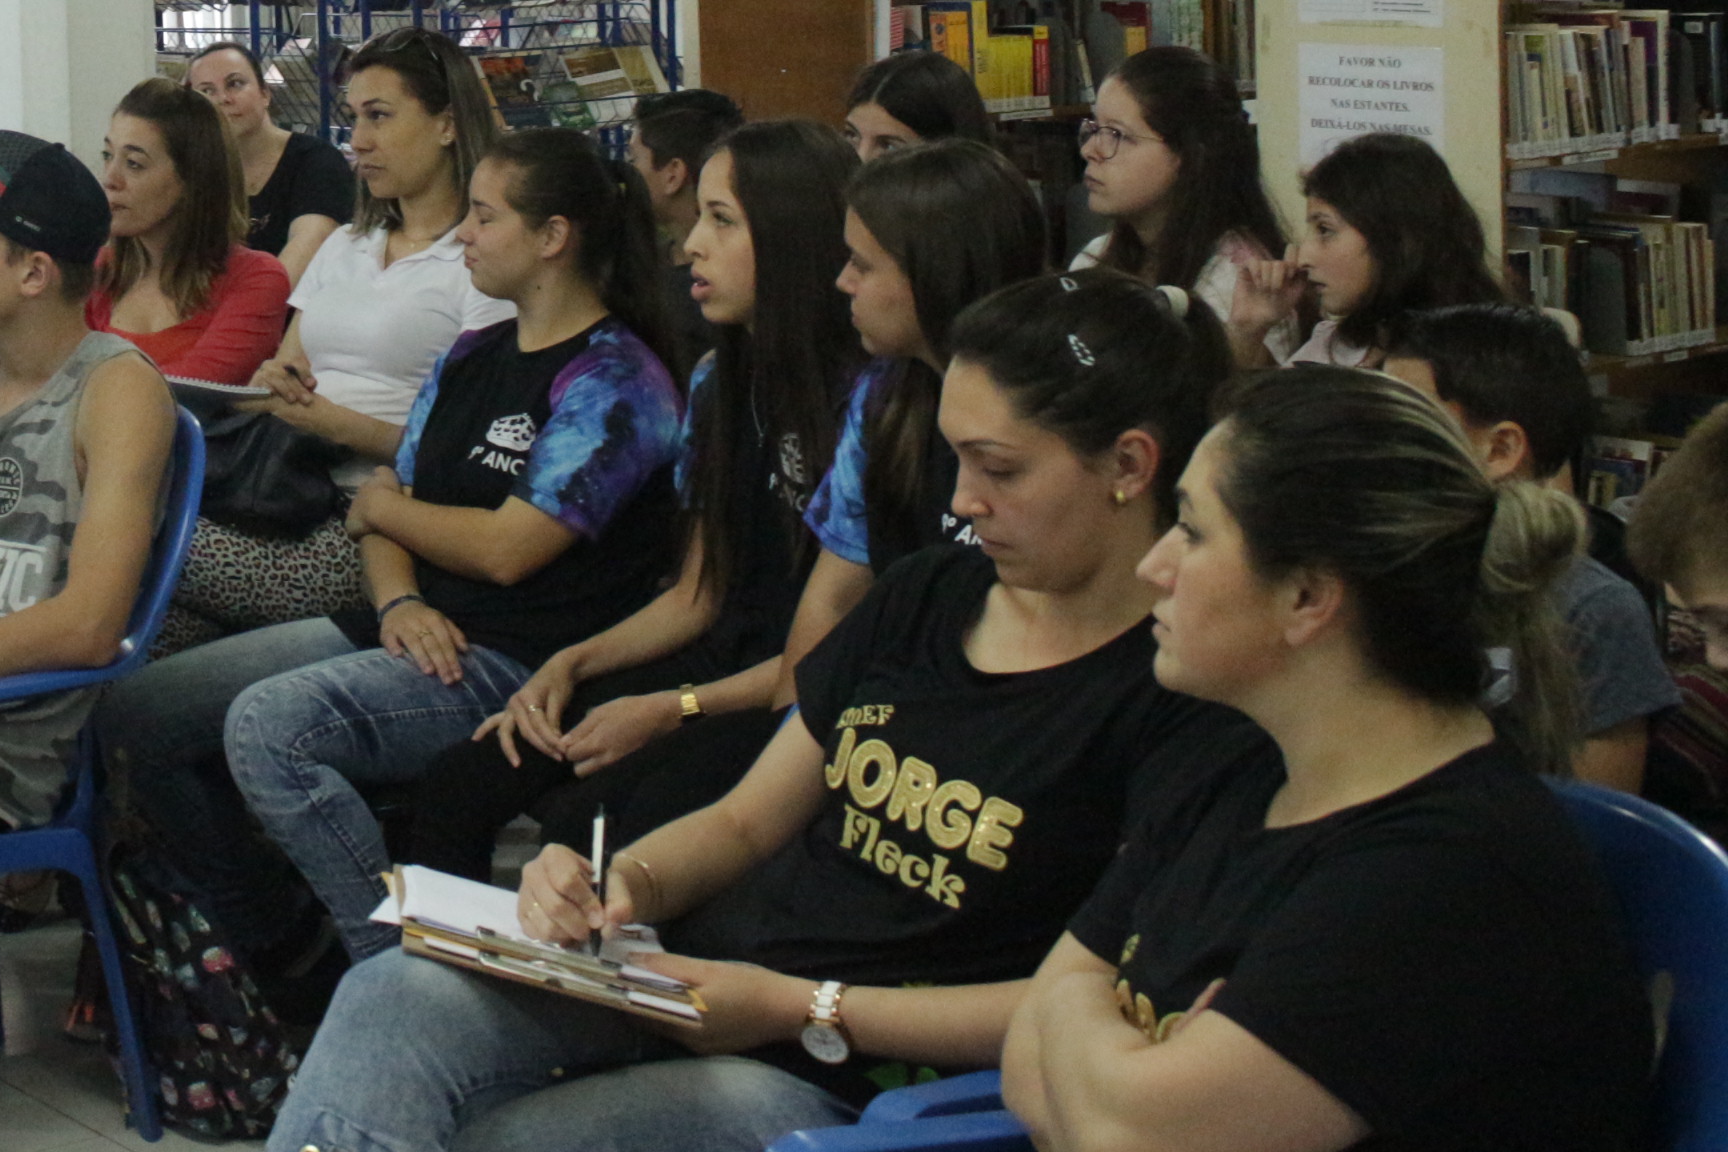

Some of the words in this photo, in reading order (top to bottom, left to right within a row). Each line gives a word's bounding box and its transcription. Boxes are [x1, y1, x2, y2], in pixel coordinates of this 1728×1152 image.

[1338, 55, 1376, 68] FAVOR
[1378, 56, 1402, 69] NÃO
[1308, 76, 1374, 89] RECOLOCAR
[1376, 79, 1391, 90] OS
[1393, 80, 1435, 92] LIVROS
[1331, 98, 1351, 109] NAS
[1310, 116, 1368, 131] DEIXÁ-LOS
[824, 726, 1025, 872] JORGE
[839, 802, 966, 909] Fleck
